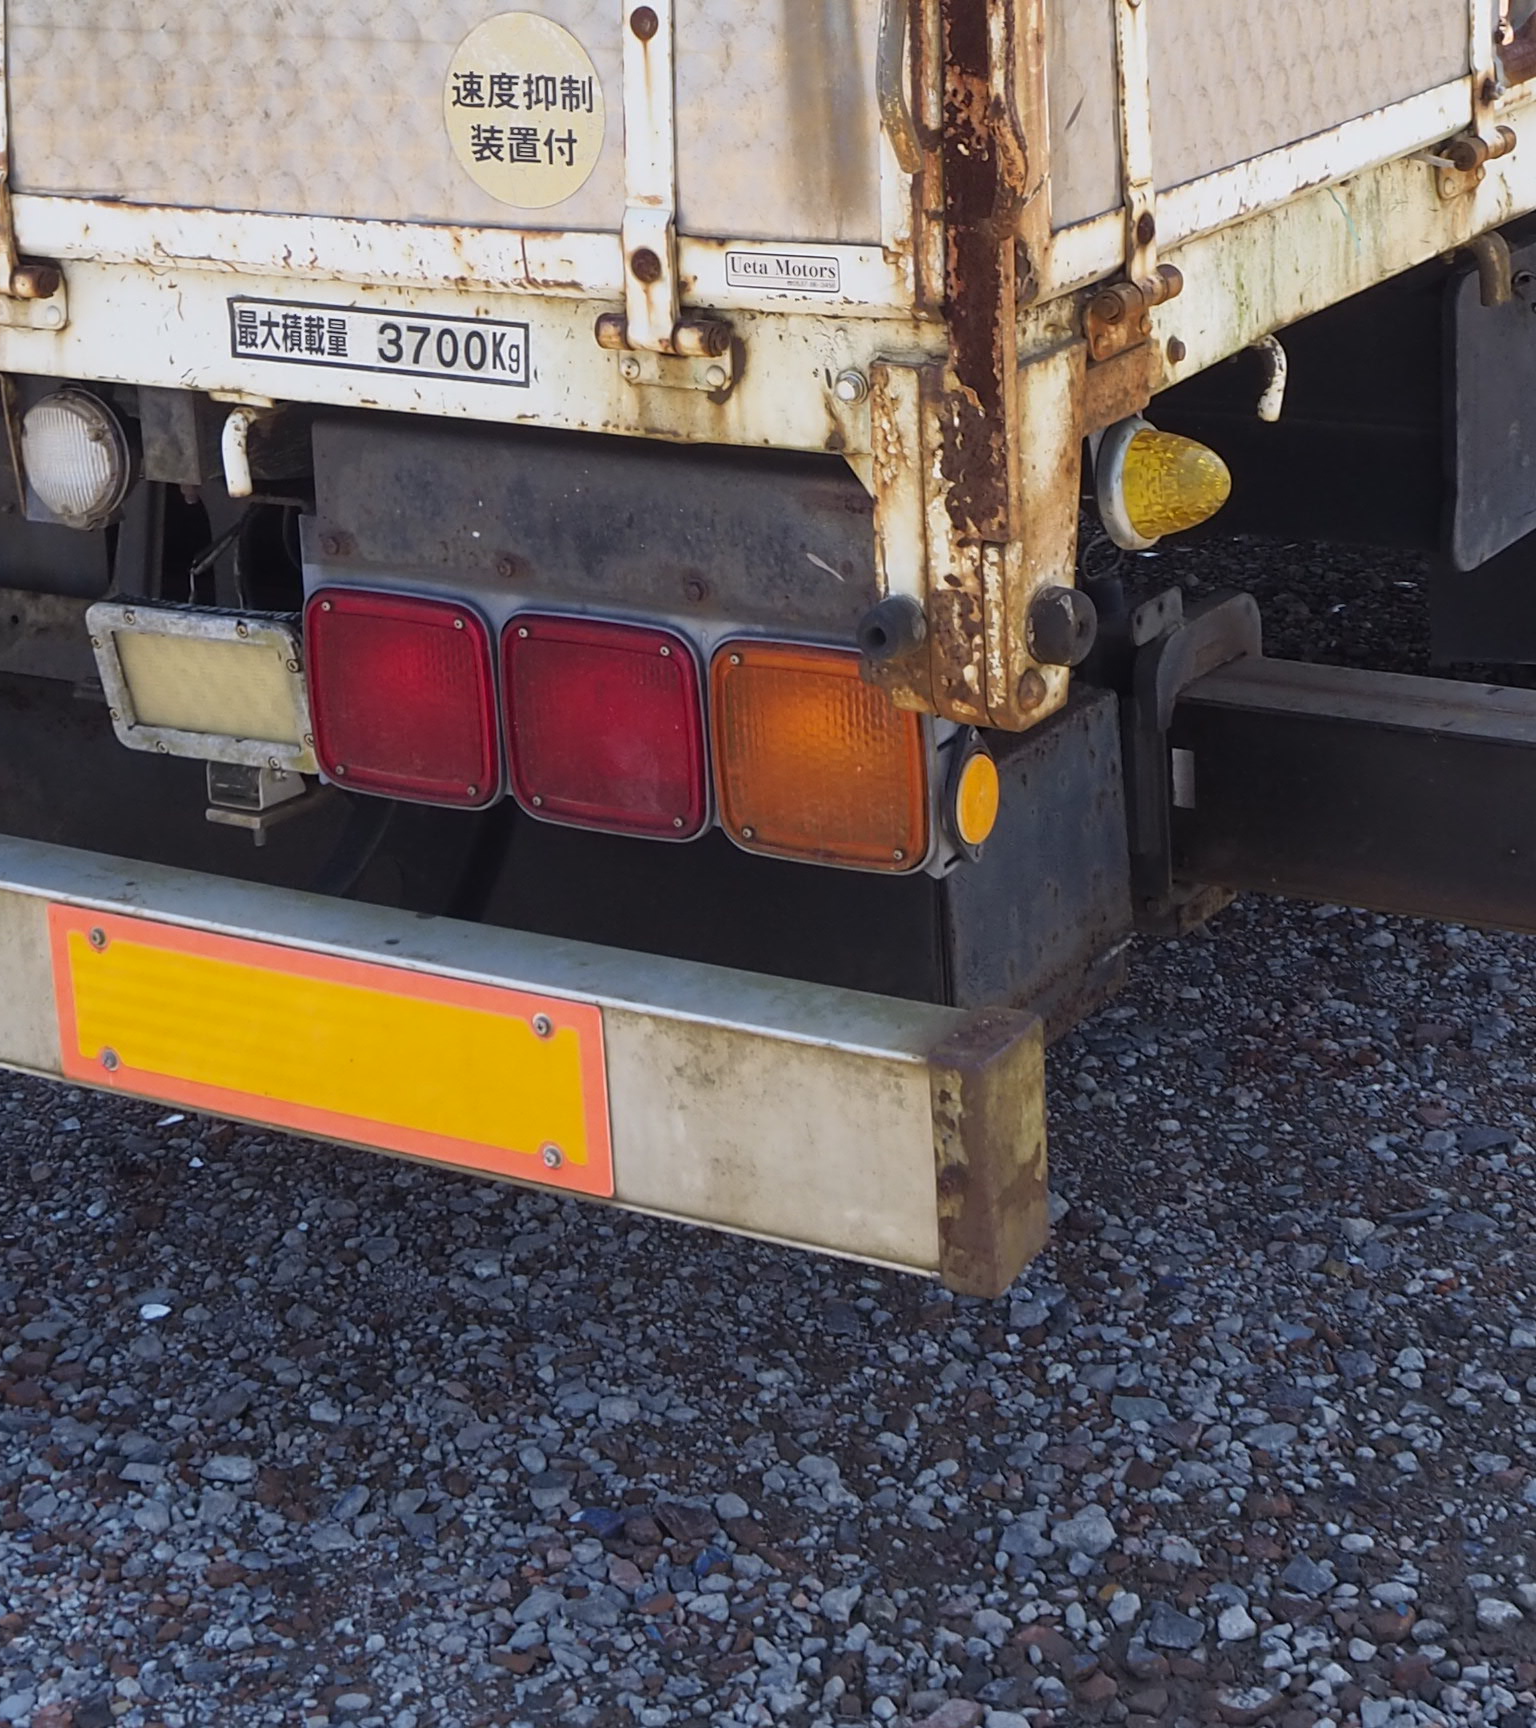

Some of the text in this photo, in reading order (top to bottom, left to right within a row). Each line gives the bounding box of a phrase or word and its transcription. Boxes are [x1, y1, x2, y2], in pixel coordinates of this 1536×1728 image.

[451, 70, 594, 114] 速度抑制
[470, 123, 578, 167] 装置付
[730, 256, 837, 279] Ueta Motors
[237, 309, 521, 374] 最大積載量 3700Kg
